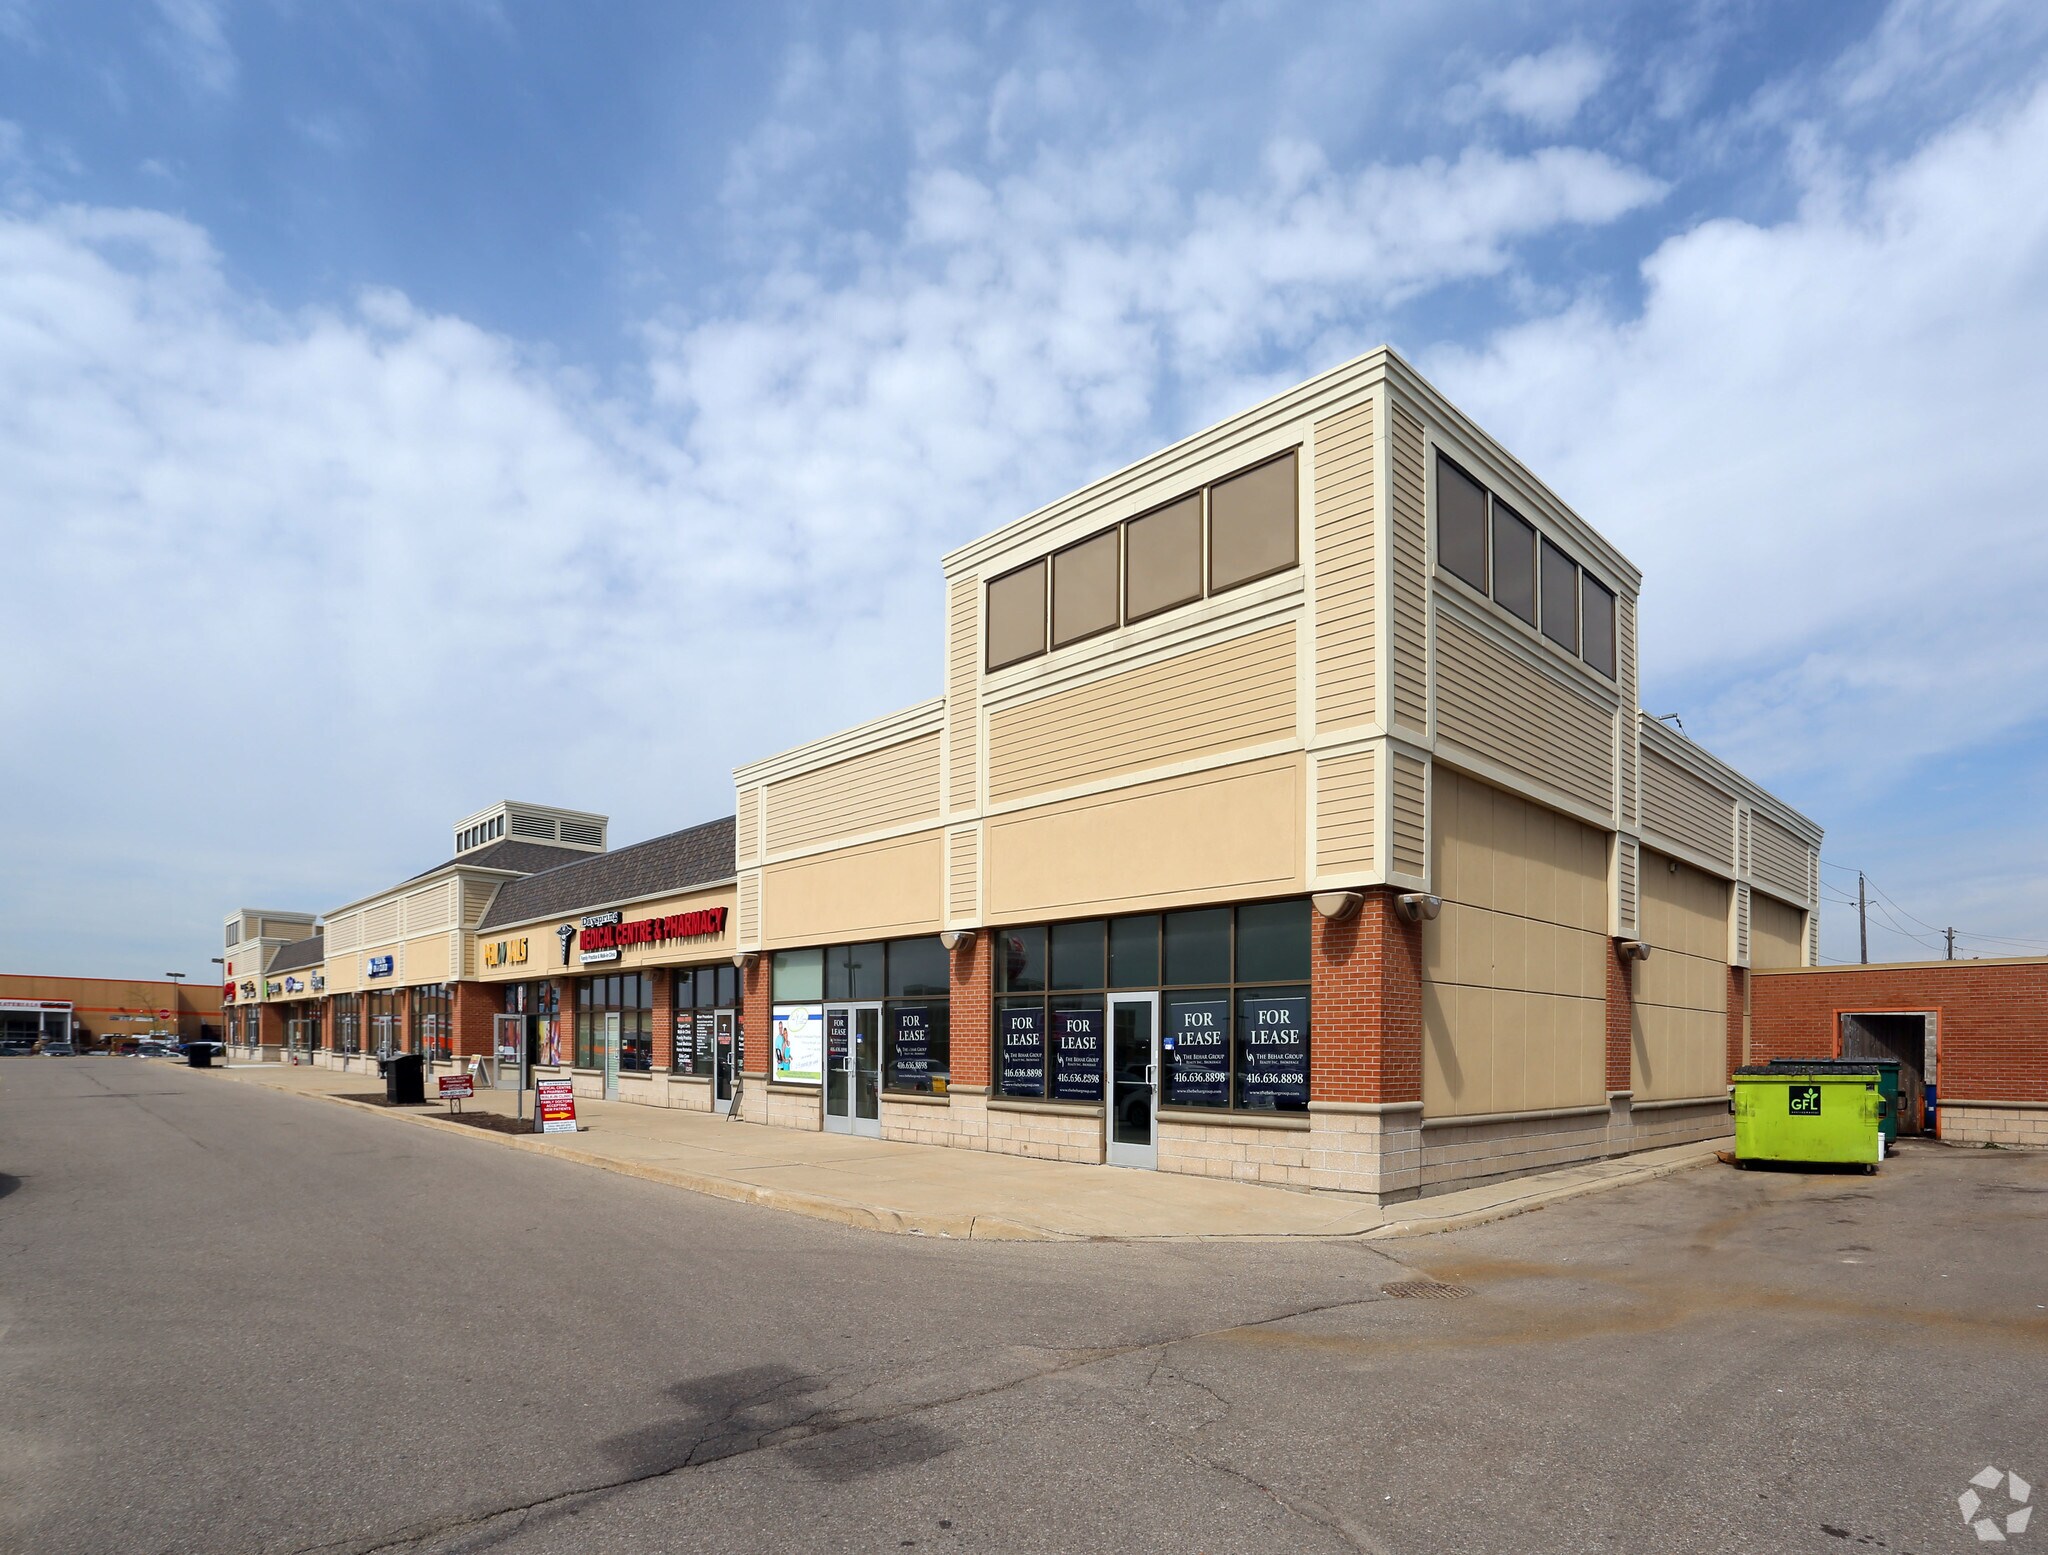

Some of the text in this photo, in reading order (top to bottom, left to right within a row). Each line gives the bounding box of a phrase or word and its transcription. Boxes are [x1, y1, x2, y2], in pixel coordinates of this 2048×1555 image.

[581, 911, 618, 927] Dayspring
[580, 907, 724, 950] MEDICAL CENTRE & PHARMACY
[833, 1019, 844, 1027] FOR
[902, 1015, 920, 1027] FOR
[1011, 1017, 1034, 1029] FOR
[1184, 1012, 1213, 1027] FOR
[1258, 1009, 1291, 1025] FOR
[831, 1028, 846, 1036] LEASE
[1066, 1019, 1091, 1032] FOR
[899, 1030, 925, 1041] LEASE
[1006, 1033, 1040, 1046] LEASE
[1178, 1031, 1221, 1046] LEASE
[1251, 1029, 1300, 1045] LEASE
[1061, 1036, 1097, 1050] LEASE
[897, 1062, 928, 1070] 416.636.8898
[1004, 1069, 1043, 1078] 416.636.8898
[1174, 1072, 1226, 1082] 416.636.8898
[1246, 1073, 1304, 1084] 416.636.8898
[1791, 1096, 1818, 1110] GFL
